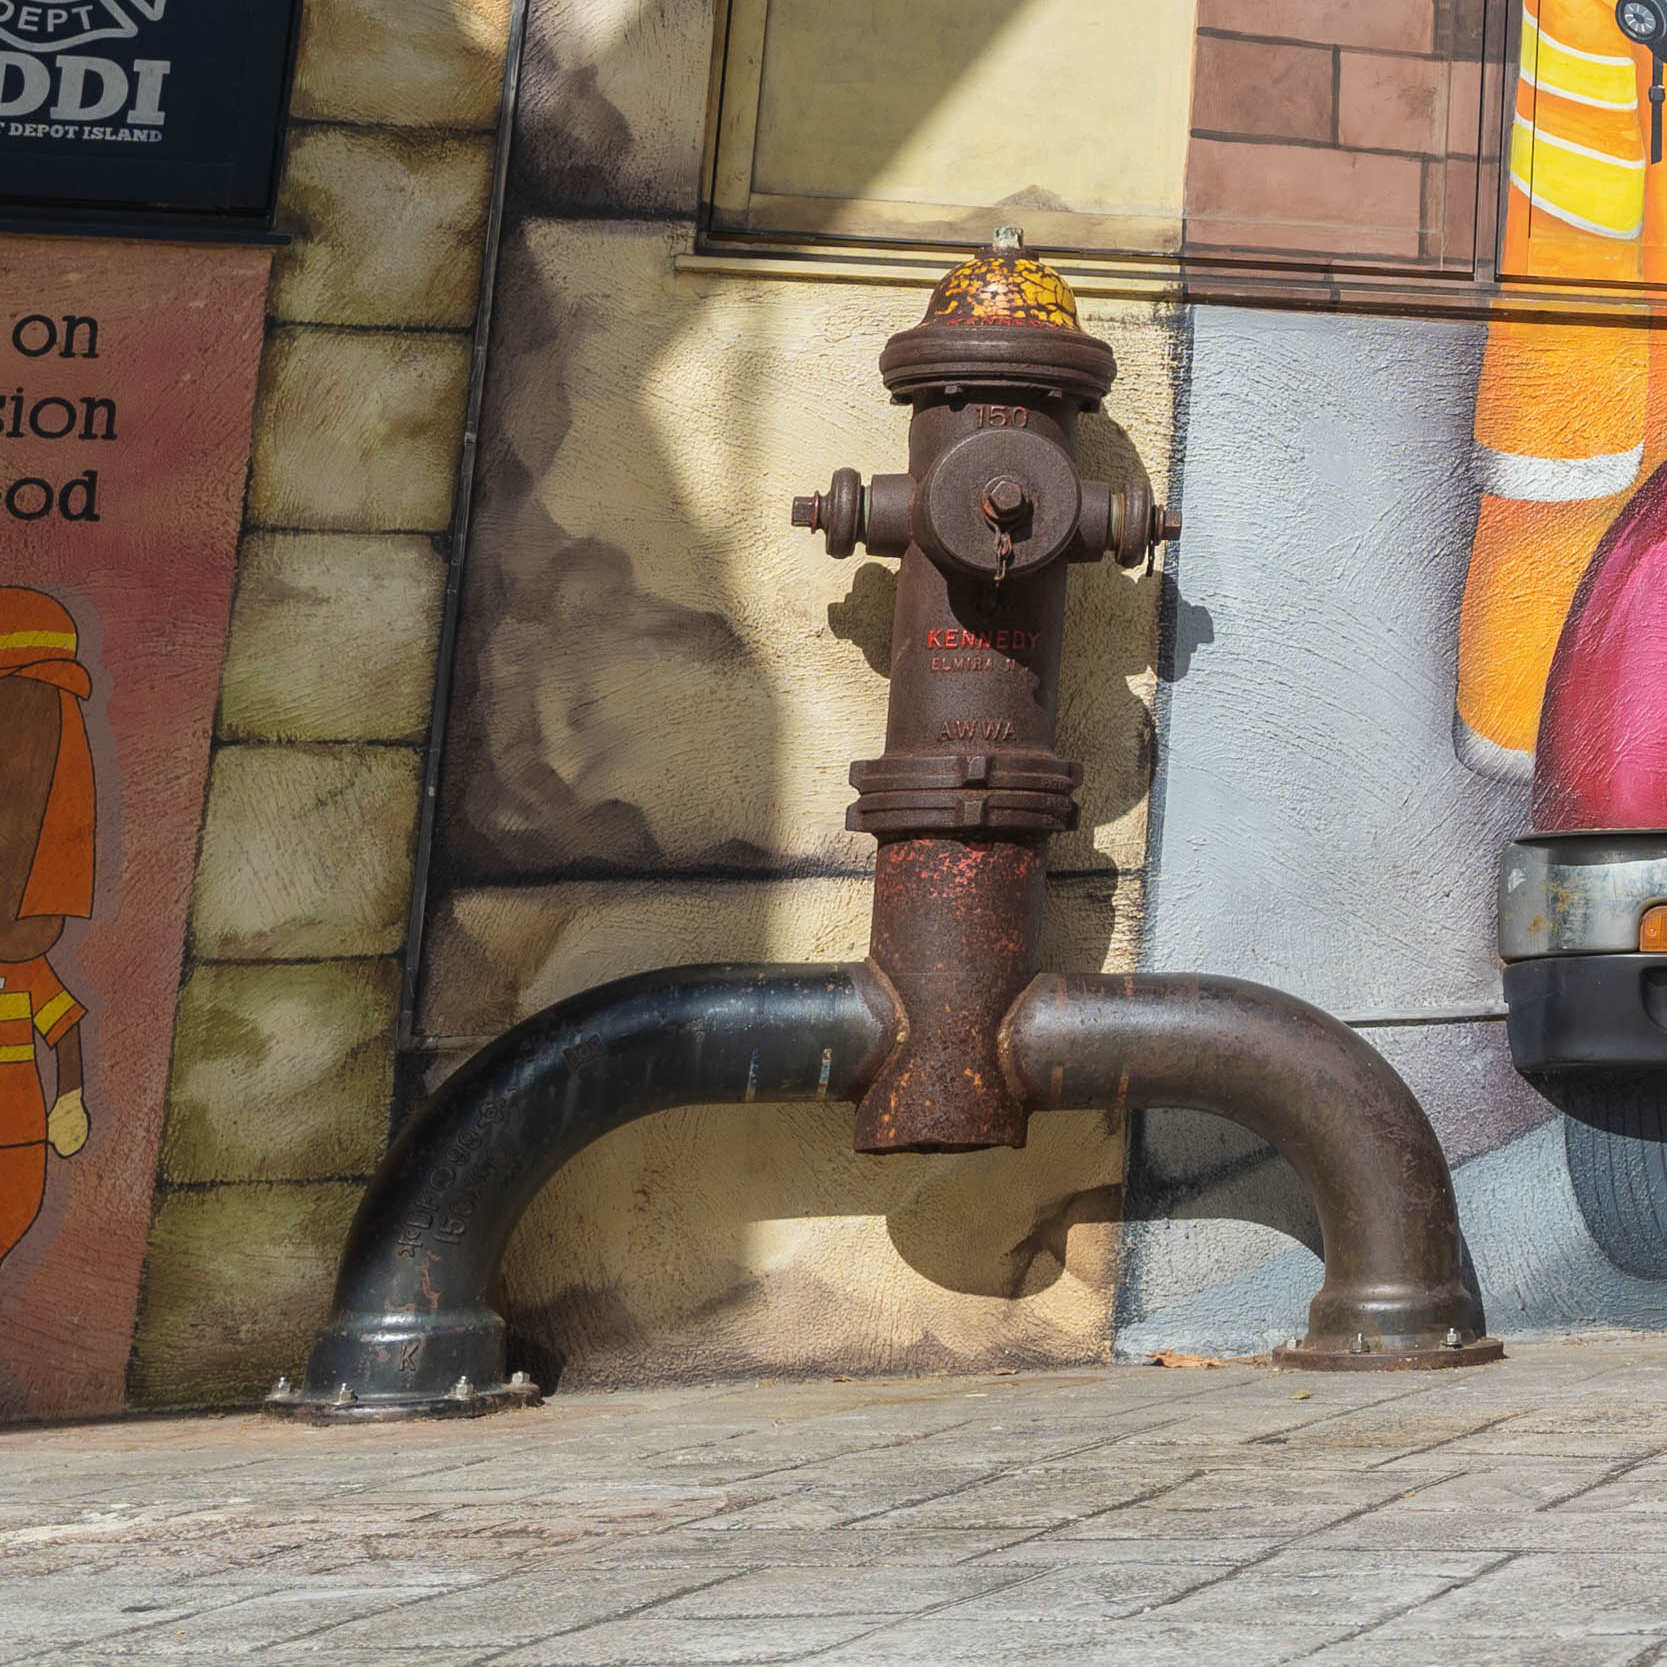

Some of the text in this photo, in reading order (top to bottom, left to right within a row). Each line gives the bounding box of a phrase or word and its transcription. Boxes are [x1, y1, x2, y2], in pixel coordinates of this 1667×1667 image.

[8, 122, 79, 139] DEPOT
[82, 126, 163, 143] ISLAND
[12, 314, 99, 358] on
[0, 387, 118, 440] ion
[976, 405, 1029, 428] 150
[927, 629, 1041, 650] KENNEDY
